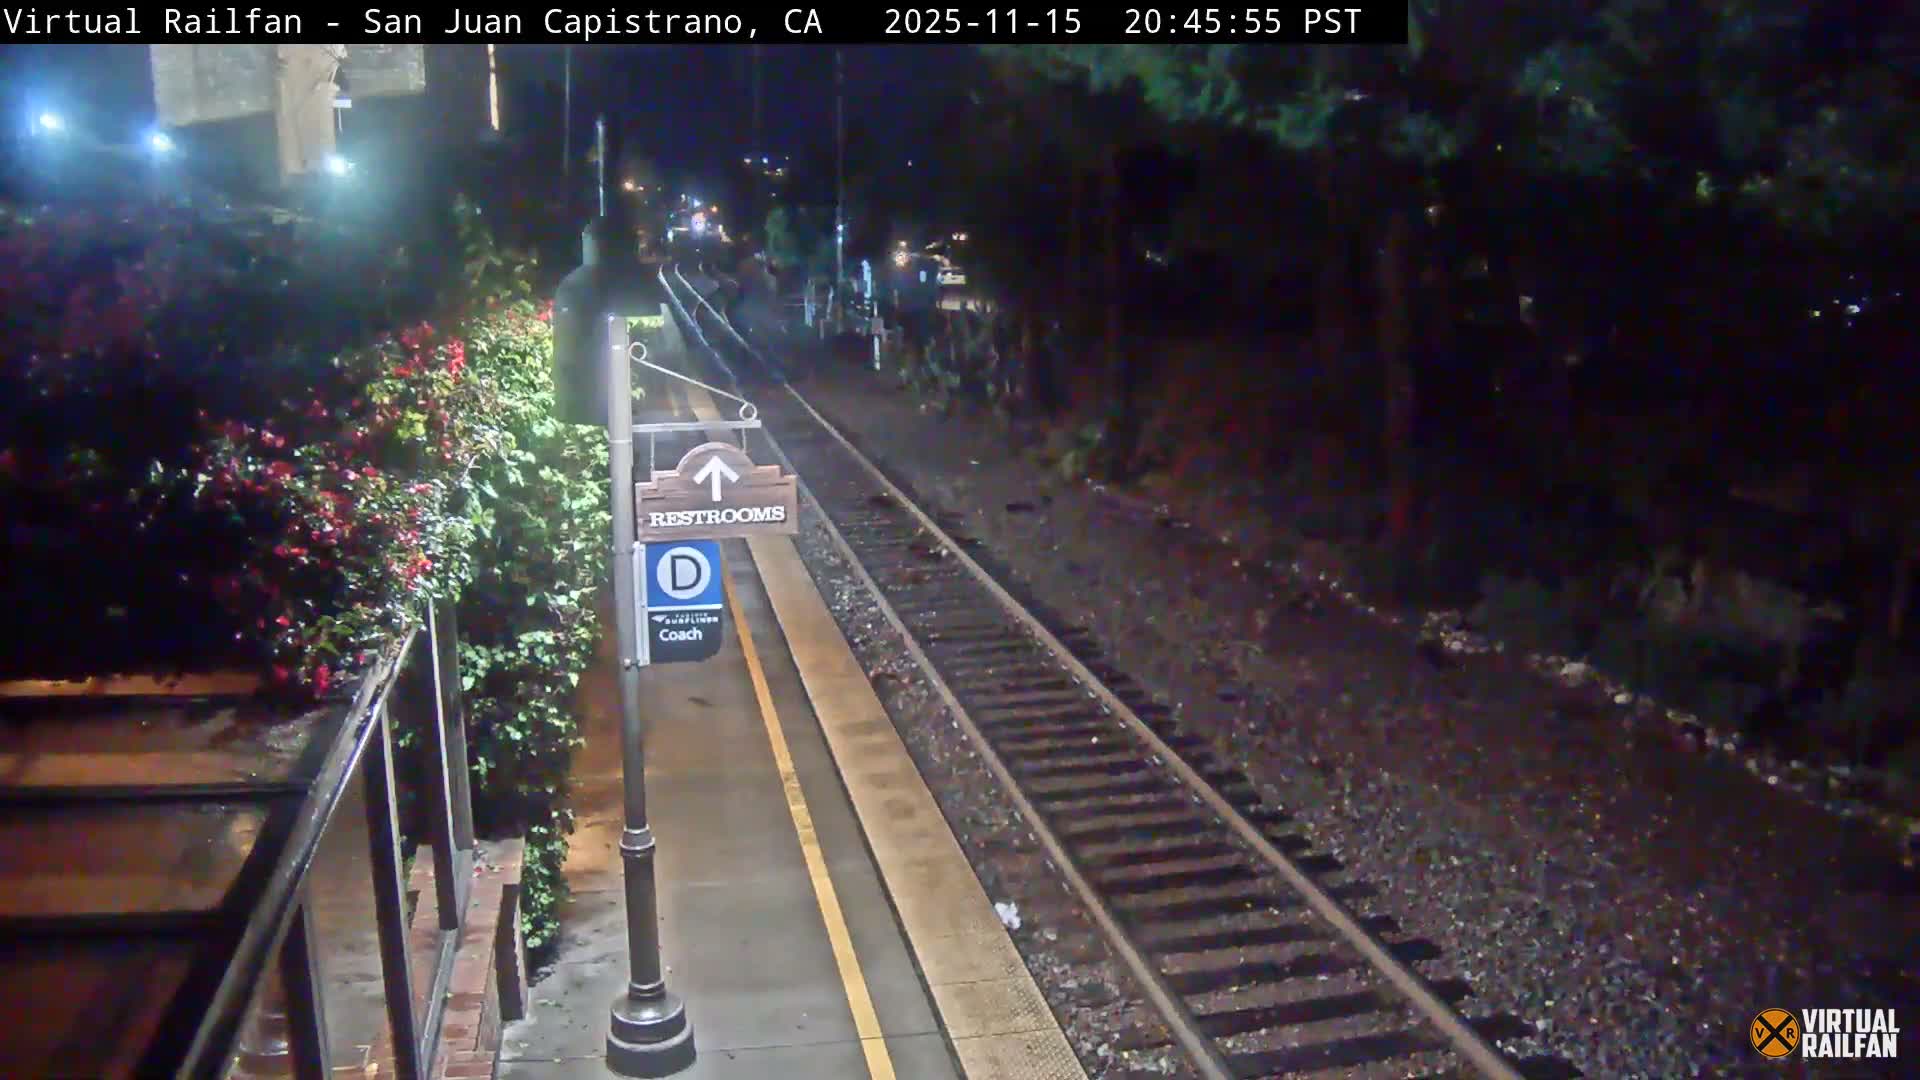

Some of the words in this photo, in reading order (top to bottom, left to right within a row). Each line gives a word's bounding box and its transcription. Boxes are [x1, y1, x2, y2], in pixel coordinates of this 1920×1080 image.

[649, 505, 785, 528] RESTROOMS
[671, 554, 702, 591] D
[659, 626, 703, 641] Coach
